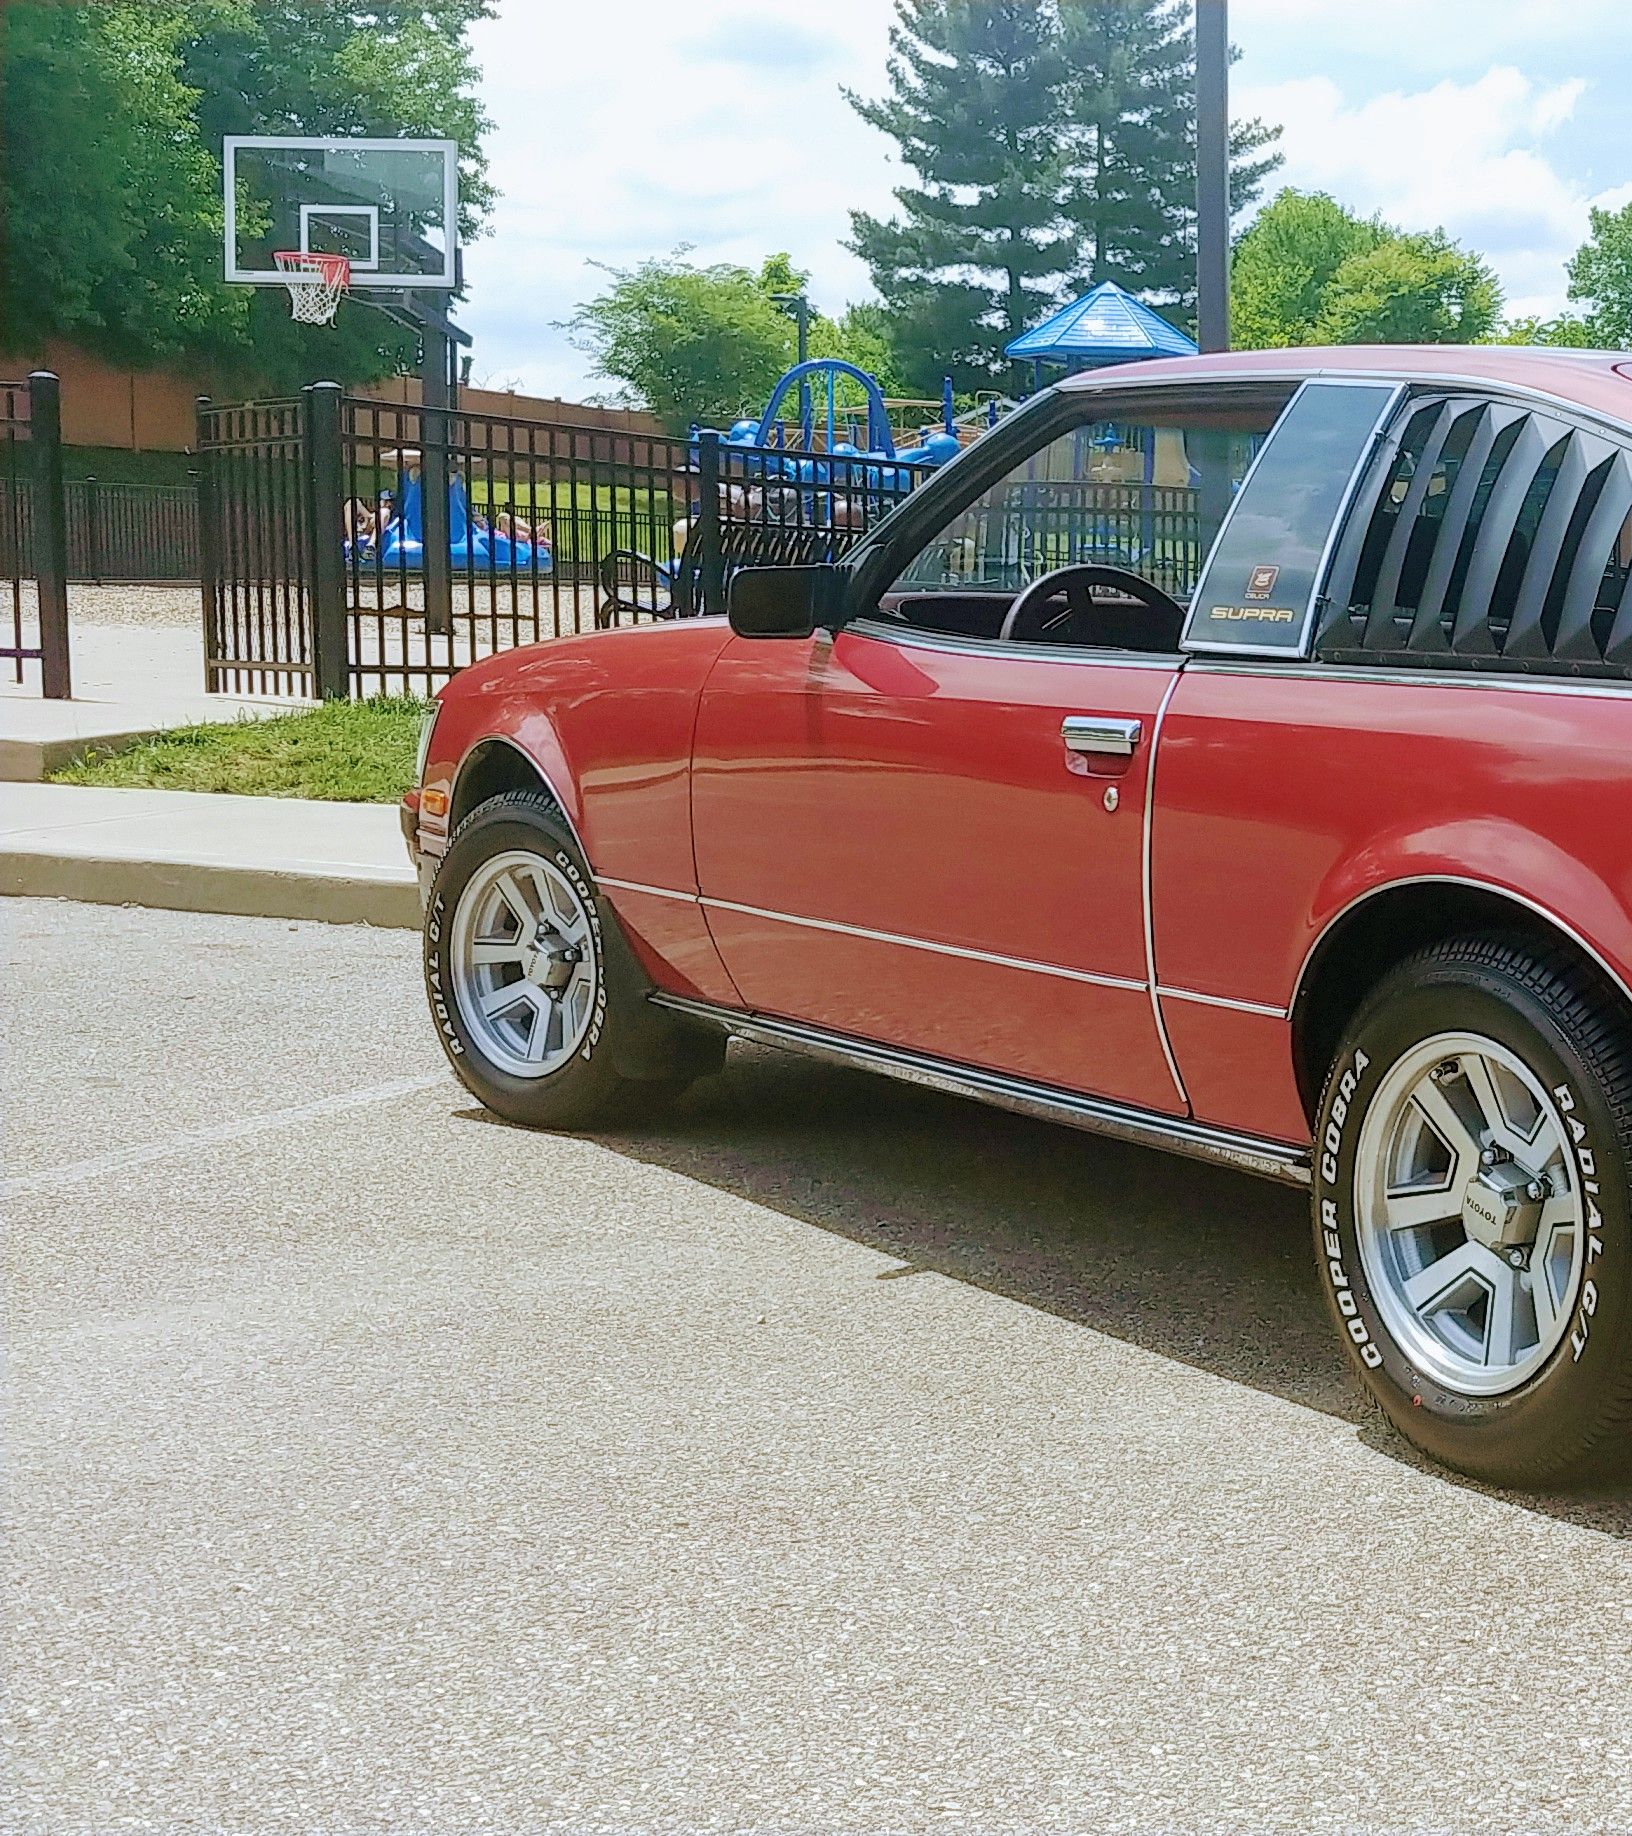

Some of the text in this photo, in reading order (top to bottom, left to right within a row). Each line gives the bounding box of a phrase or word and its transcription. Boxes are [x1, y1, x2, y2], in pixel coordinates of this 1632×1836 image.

[1210, 606, 1294, 623] SUPRA
[555, 850, 603, 956] COOPER
[427, 892, 465, 1056] RADIAL G/T
[1321, 1048, 1384, 1370] COOPER COBRA
[1466, 1194, 1497, 1226] TOYOTA
[1552, 1082, 1605, 1364] RADIAL G/T
